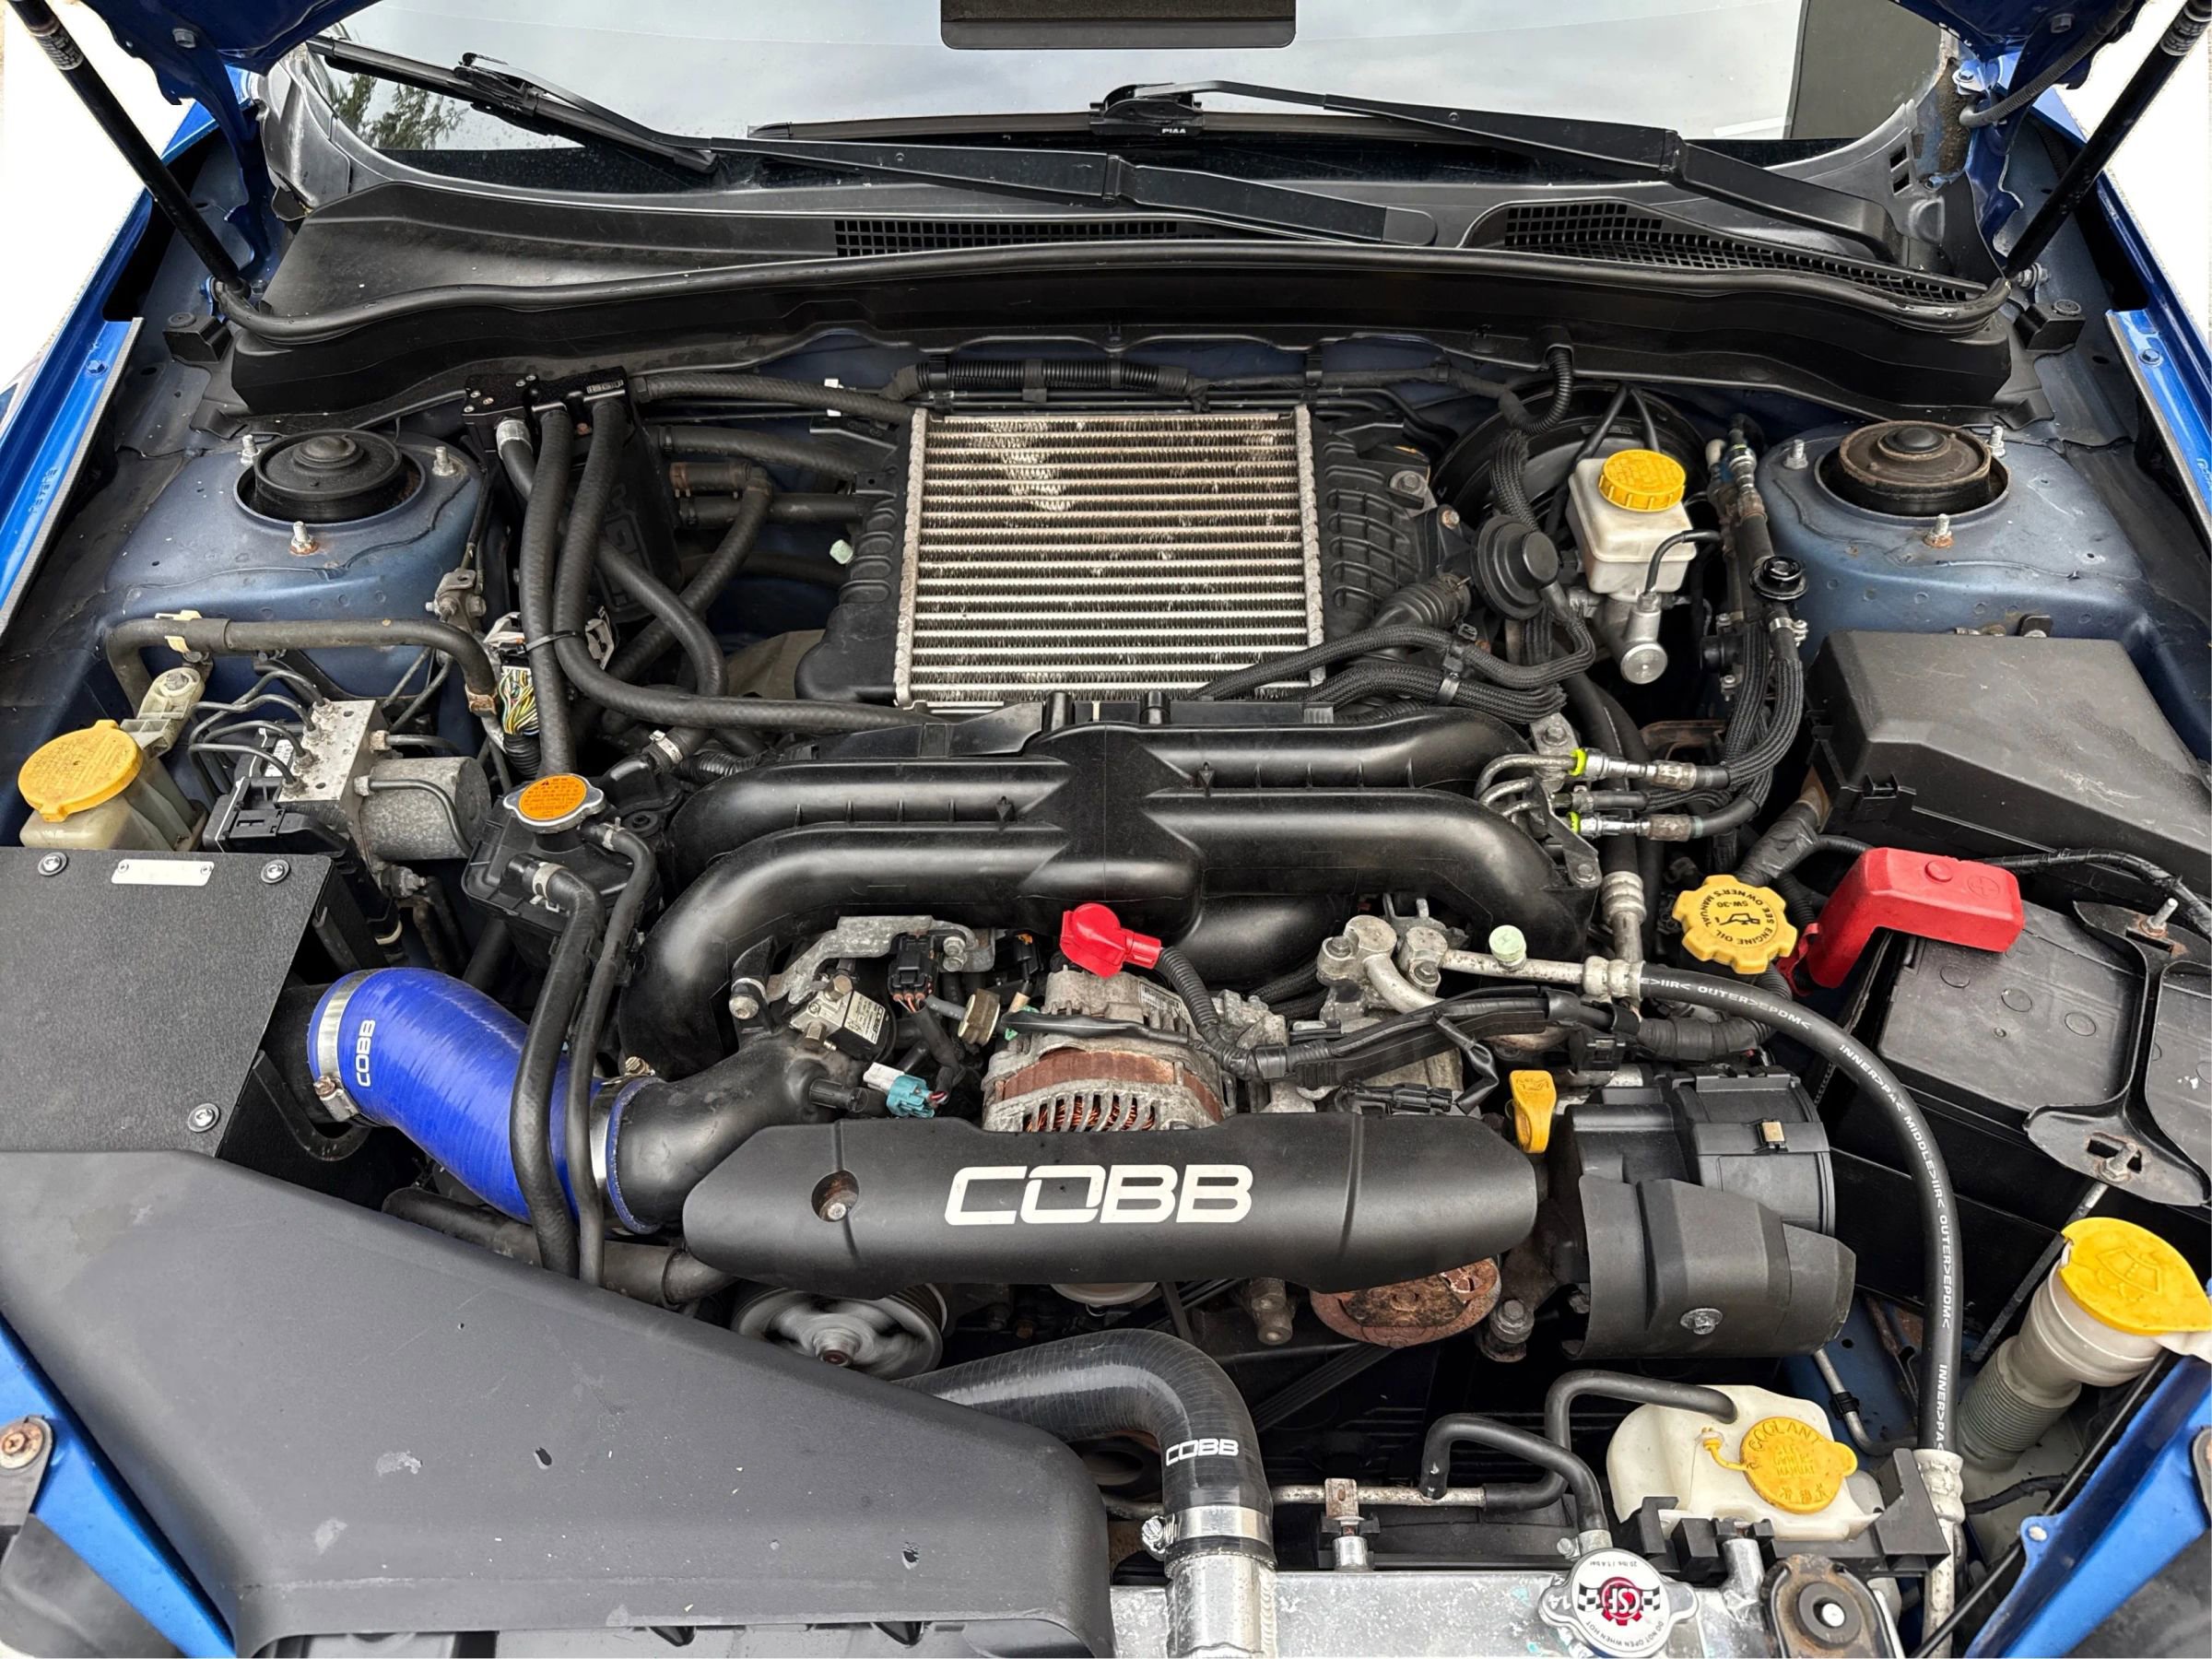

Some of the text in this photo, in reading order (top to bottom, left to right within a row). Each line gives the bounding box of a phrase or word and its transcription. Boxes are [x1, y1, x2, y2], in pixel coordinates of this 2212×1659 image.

[1700, 888, 1775, 928] SEE OWNER'S MANUAL
[1714, 927, 1772, 945] ENGINE OIL
[355, 1018, 377, 1088] COBB
[944, 1164, 1253, 1226] COBB
[1748, 1420, 1825, 1453] COOLANT
[1165, 1438, 1239, 1466] COBB
[1608, 1587, 1641, 1614] CSF
[1585, 1620, 1665, 1648] DO NOT OPEN WHEN HOT
